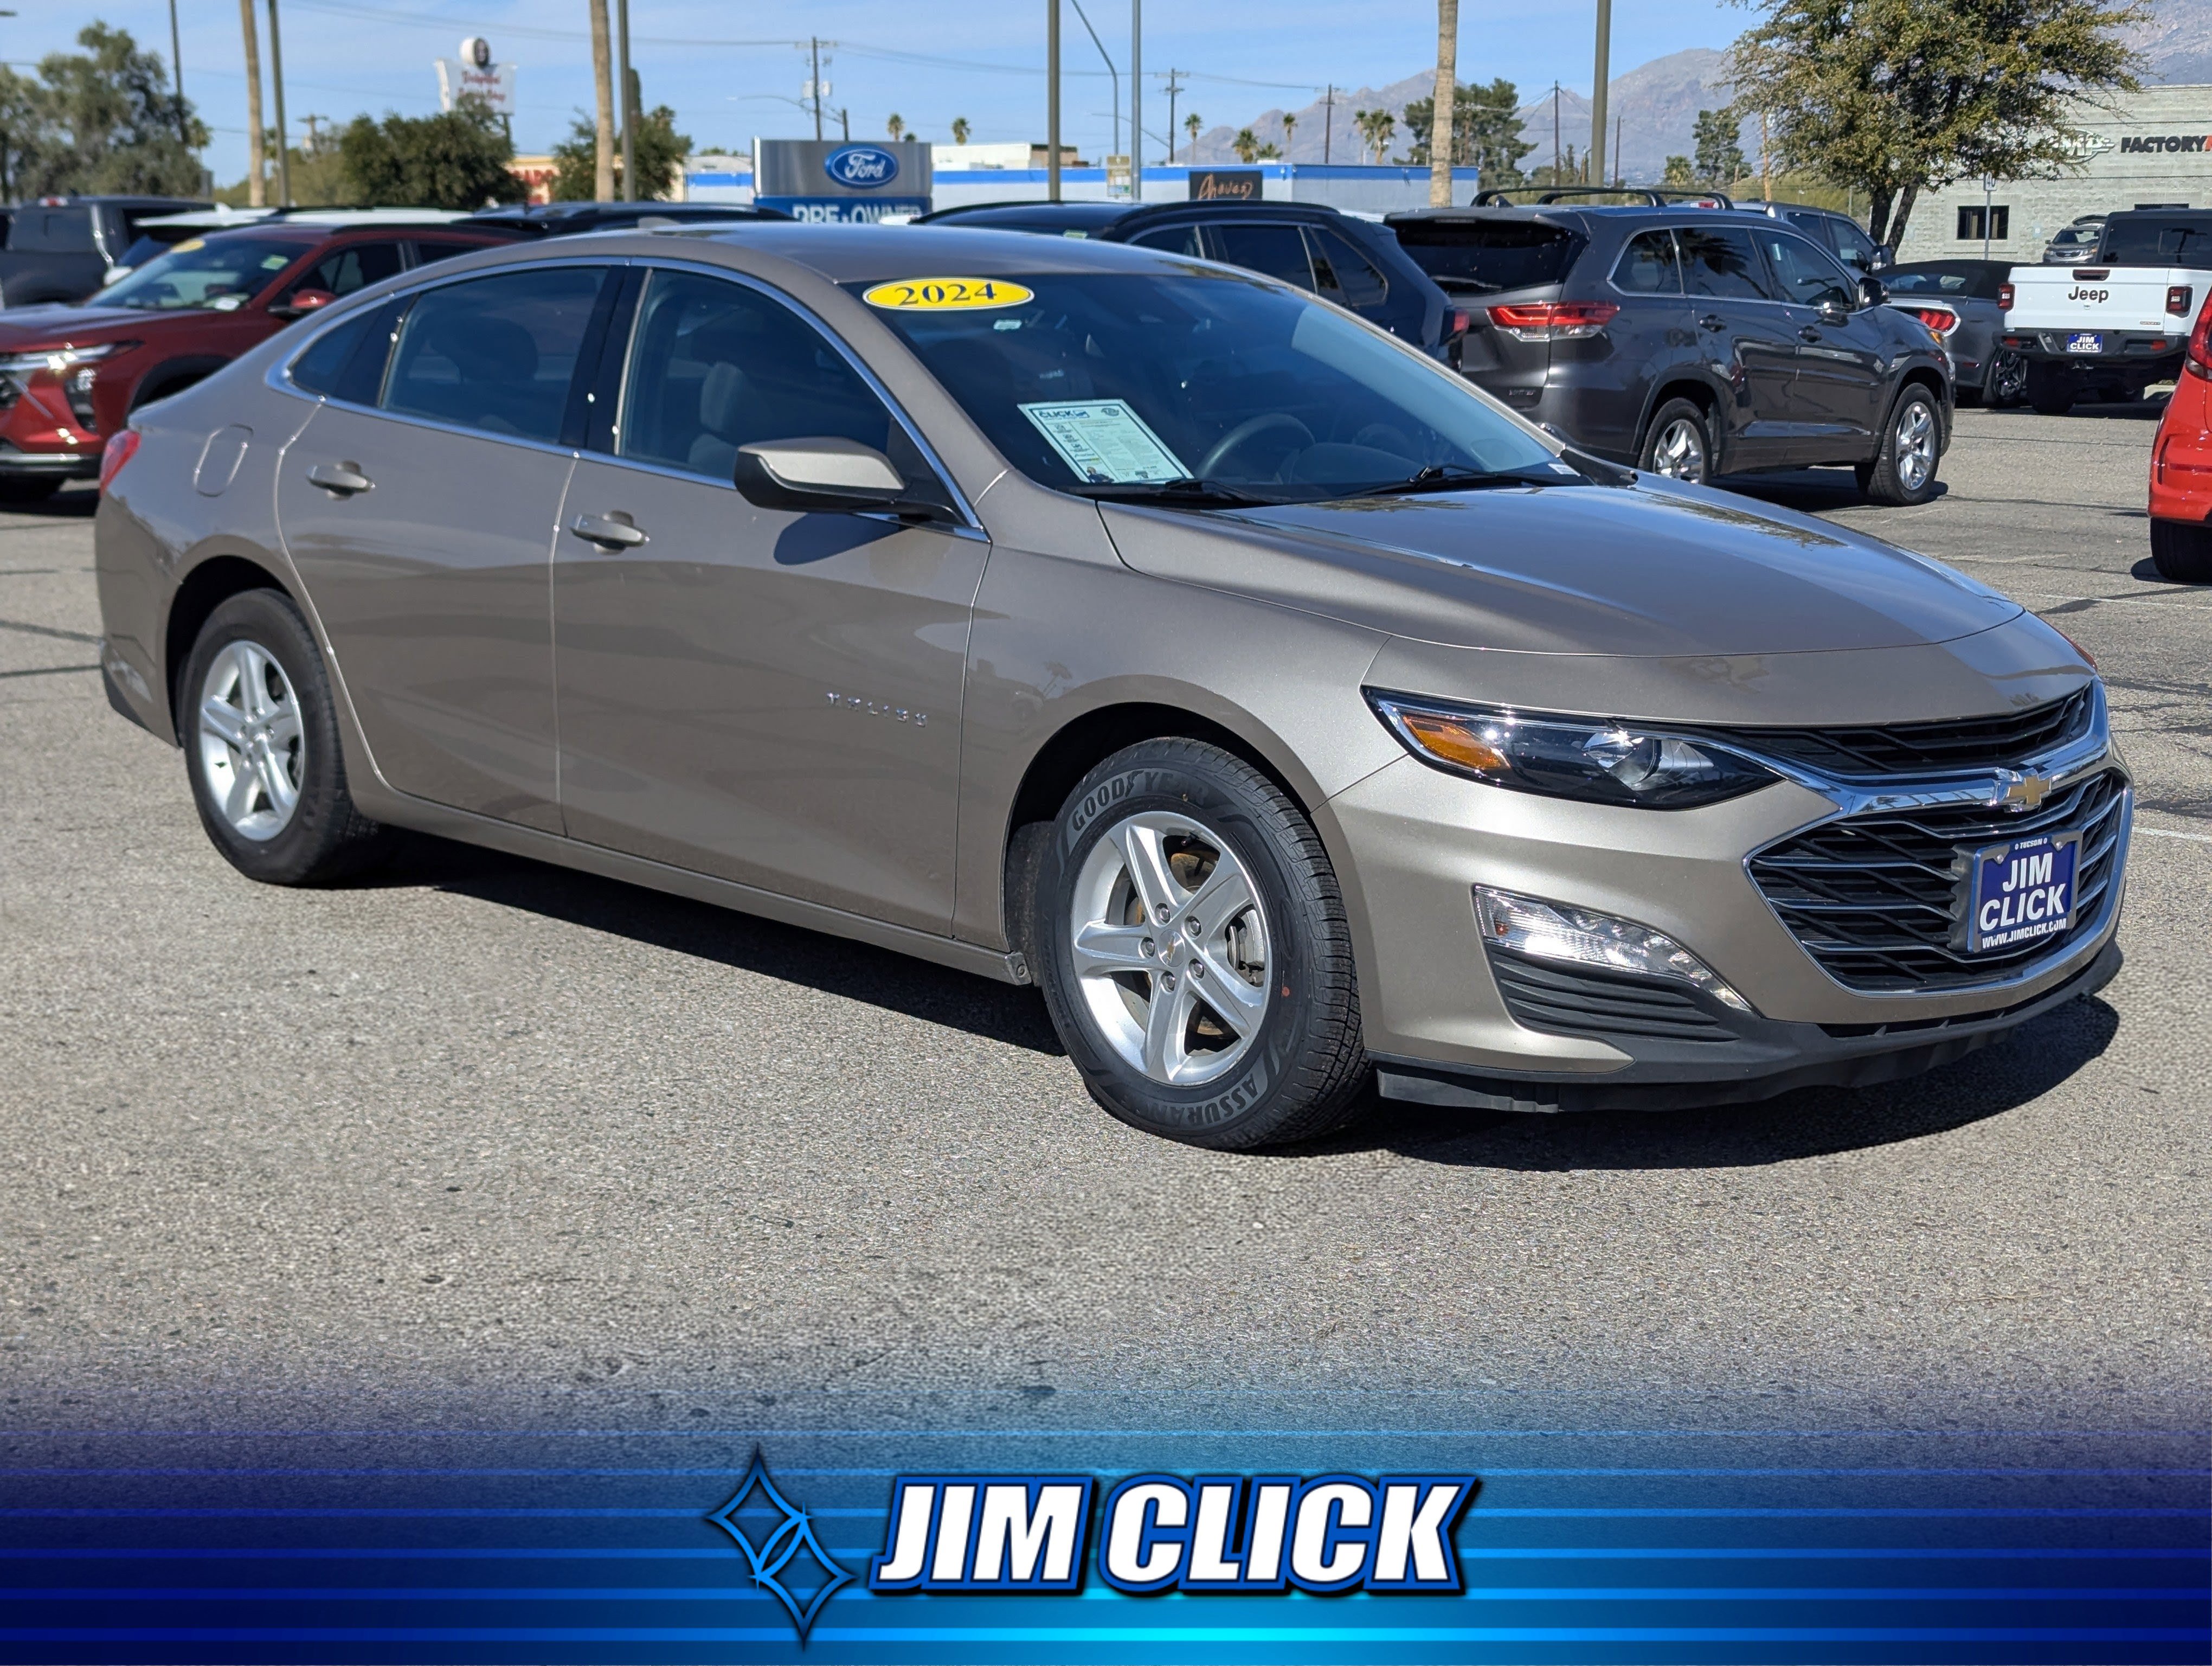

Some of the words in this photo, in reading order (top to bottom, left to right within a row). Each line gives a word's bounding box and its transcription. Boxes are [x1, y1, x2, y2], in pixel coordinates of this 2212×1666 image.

[844, 153, 886, 178] Ford
[895, 282, 997, 306] 2024
[2068, 286, 2109, 303] Jeep
[2020, 838, 2043, 849] TUCSON
[2002, 852, 2053, 892] JIM
[1979, 883, 2067, 931] CLICK
[1982, 918, 2067, 949] WWW.JIMCLICK.COM
[1123, 1073, 1259, 1127] ASSURAN
